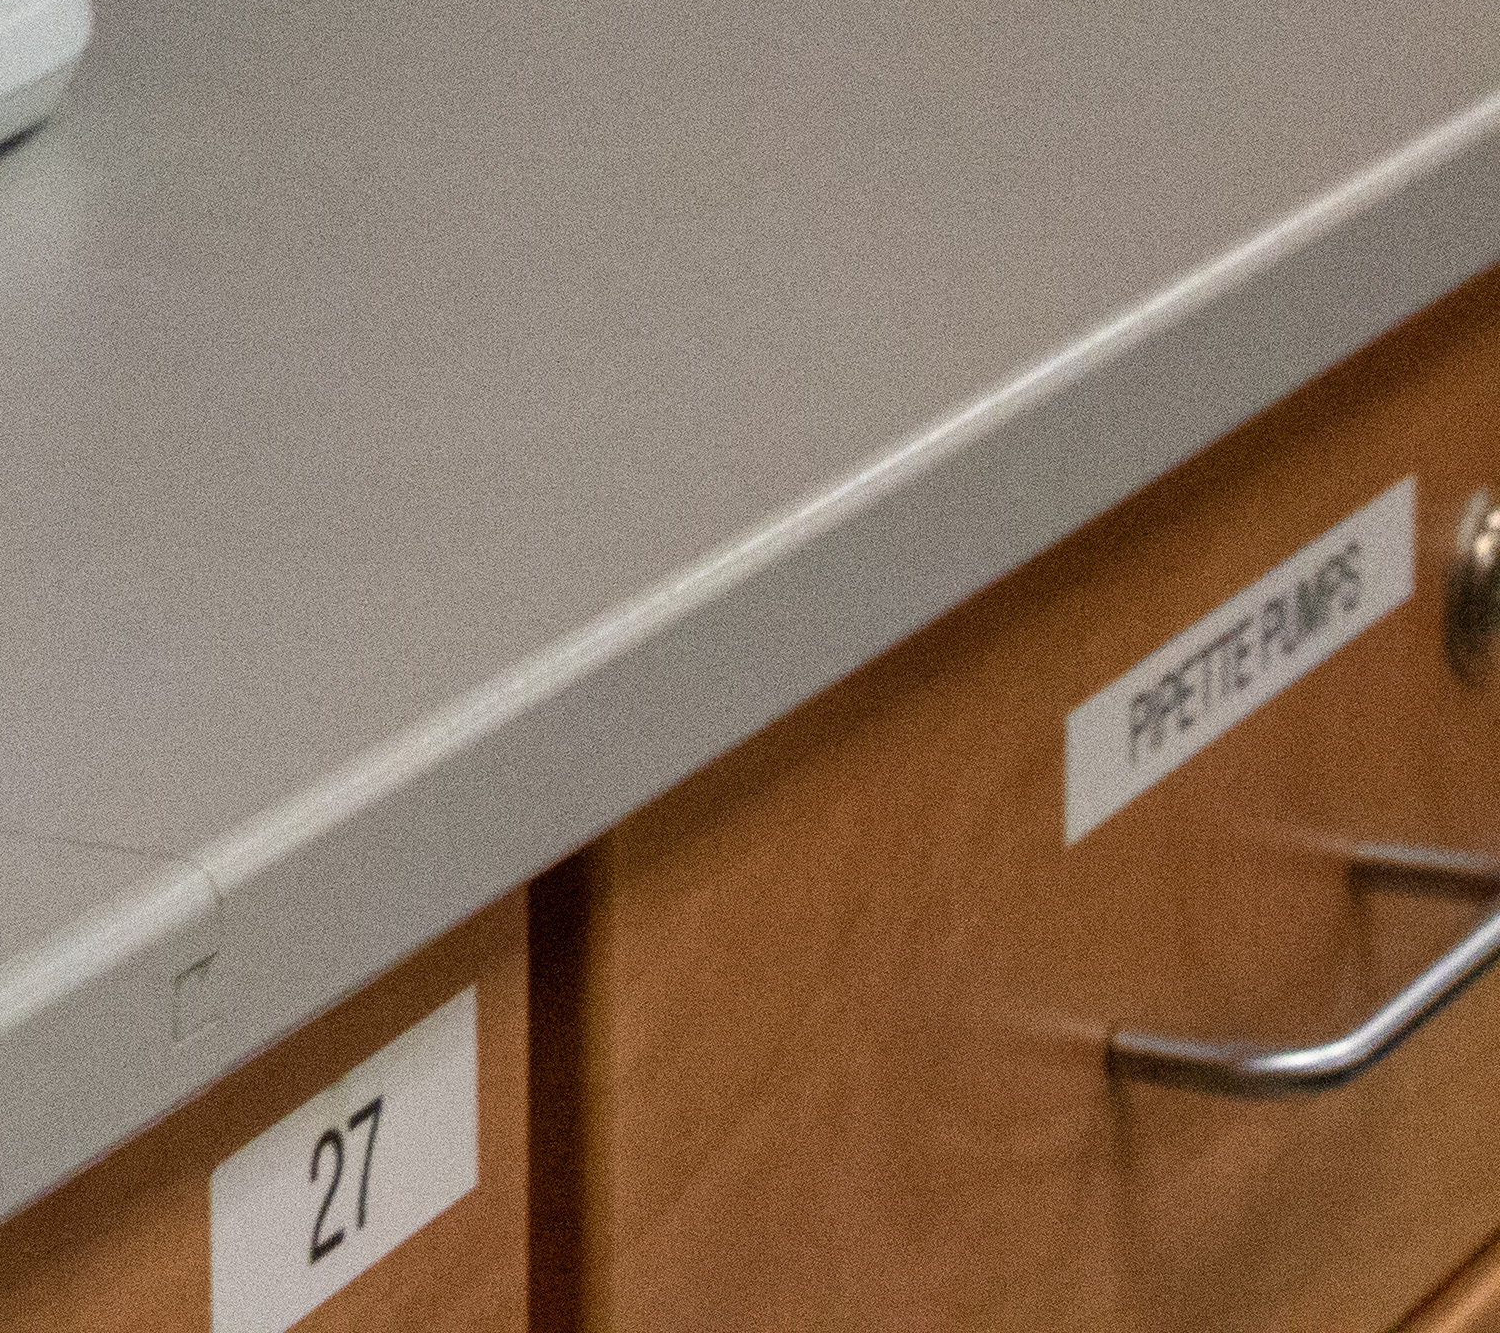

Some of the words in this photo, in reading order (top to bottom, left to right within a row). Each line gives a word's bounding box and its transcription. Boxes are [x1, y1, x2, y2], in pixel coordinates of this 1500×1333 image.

[1128, 617, 1252, 769] PIPETTE
[1260, 540, 1362, 671] PUMPS
[308, 1094, 384, 1265] 27
